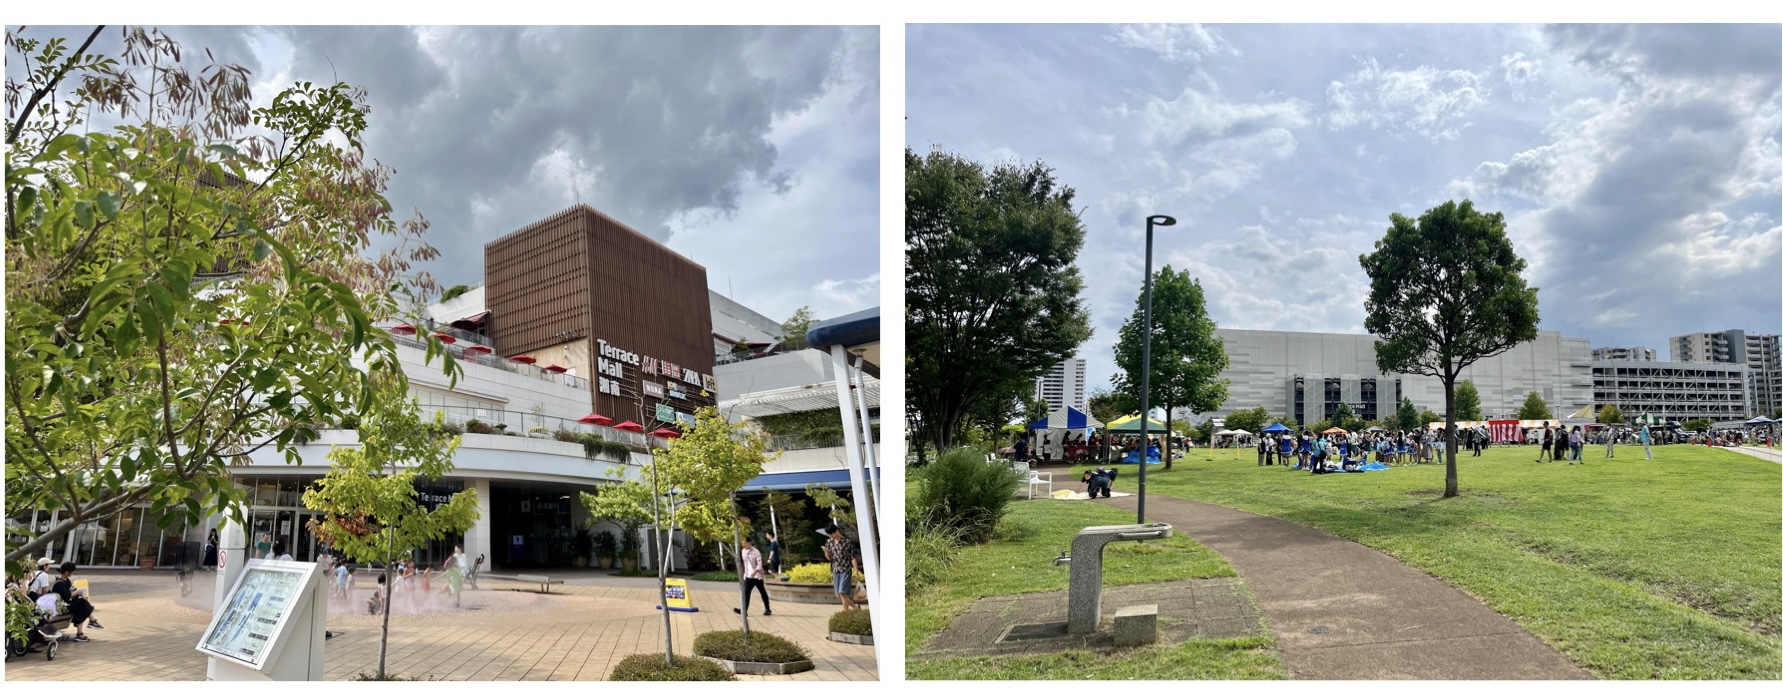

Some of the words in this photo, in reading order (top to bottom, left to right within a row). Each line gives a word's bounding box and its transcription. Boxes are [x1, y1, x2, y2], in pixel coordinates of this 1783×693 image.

[597, 339, 639, 366] Terrace
[598, 357, 623, 378] Mall
[641, 355, 658, 377] H&M
[599, 377, 620, 397] 湘南
[420, 492, 447, 503] Terace
